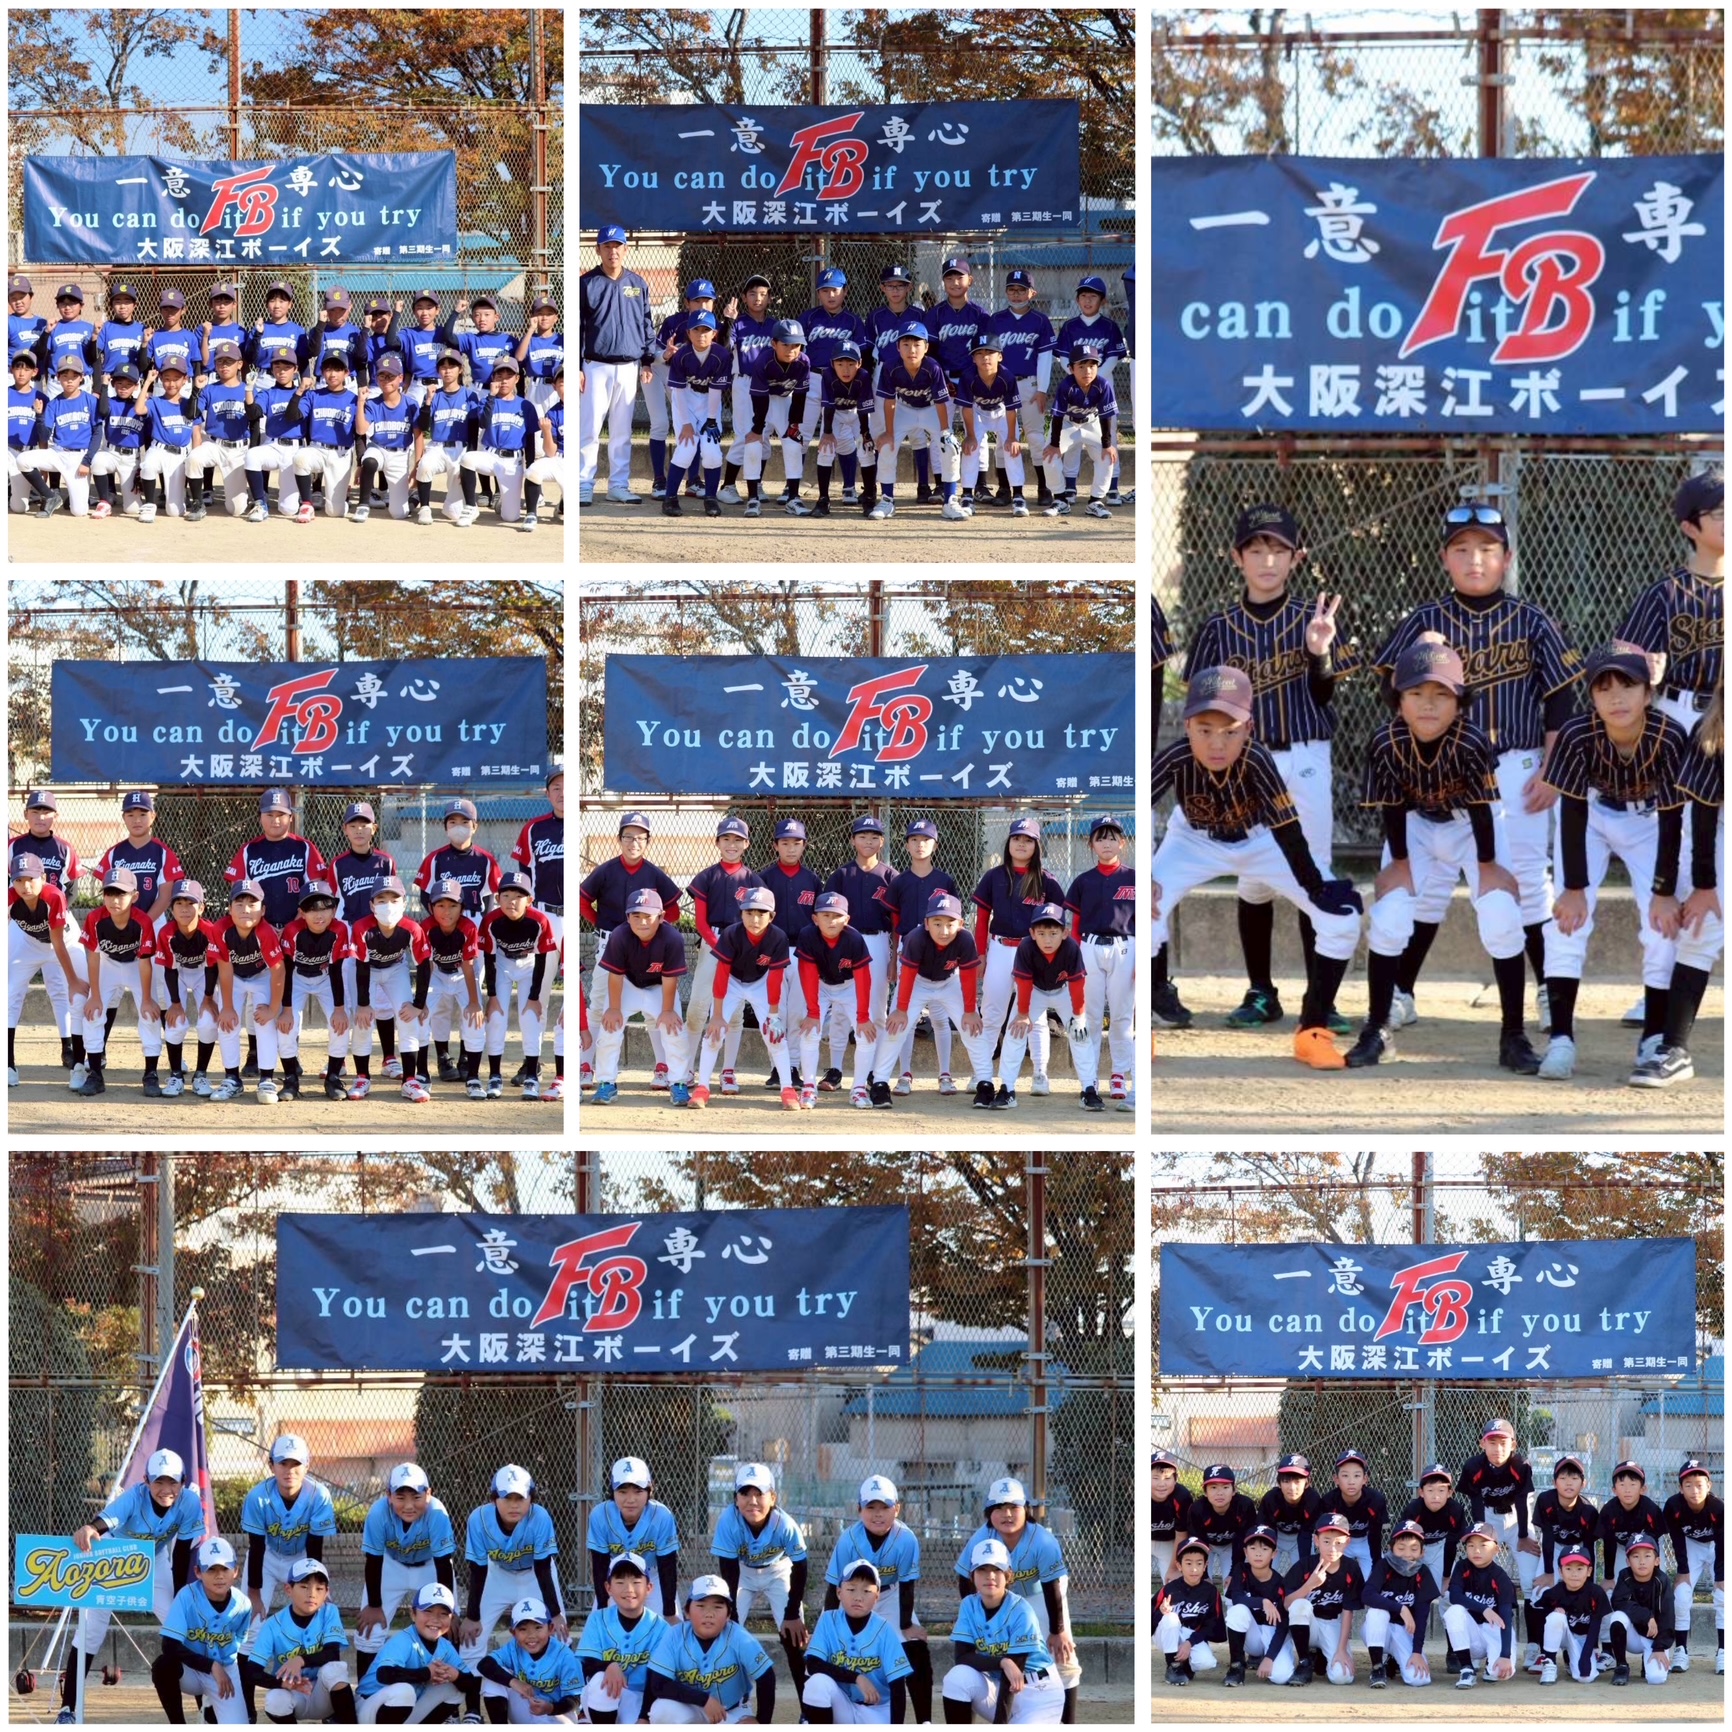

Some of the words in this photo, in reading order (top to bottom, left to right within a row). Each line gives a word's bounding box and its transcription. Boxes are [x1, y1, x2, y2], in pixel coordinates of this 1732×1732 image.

[773, 111, 869, 200] FB
[599, 164, 659, 189] You
[674, 170, 726, 189] can
[741, 165, 776, 189] do
[872, 165, 897, 190] if
[913, 168, 971, 193] you
[988, 163, 1038, 190] try
[199, 165, 279, 237] FB
[702, 199, 943, 226] 大阪深江ボーイズ
[48, 206, 99, 228] You
[112, 212, 157, 228] can
[170, 208, 200, 229] do
[281, 206, 303, 228] if
[317, 210, 366, 230] you
[380, 205, 422, 227] try
[137, 235, 341, 260] 大阪深江ボーイズ
[1398, 170, 1605, 364] FB
[1180, 300, 1293, 340] can
[1326, 286, 1403, 339] do
[1613, 289, 1666, 343] if
[1025, 348, 1035, 360] 7
[250, 668, 343, 754] FB
[828, 664, 933, 762] FB
[79, 718, 138, 742] You
[153, 725, 203, 744] can
[218, 719, 253, 744] do
[346, 720, 371, 745] if
[386, 724, 442, 748] you
[457, 719, 507, 745] try
[636, 720, 701, 747] You
[718, 728, 775, 748] can
[792, 722, 830, 749] do
[936, 724, 964, 751] if
[981, 728, 1045, 754] you
[1063, 723, 1118, 752] try
[180, 753, 415, 779] 大阪深江ボーイズ
[748, 761, 1014, 790] 大阪深江ボーイズ
[249, 855, 303, 876] Higanaka
[143, 876, 152, 890] 3
[286, 877, 300, 893] 10
[529, 1221, 648, 1333] FB
[312, 1287, 386, 1318] You
[405, 1295, 470, 1319] can
[488, 1288, 532, 1319] do
[652, 1289, 684, 1320] if
[704, 1294, 776, 1324] you
[796, 1287, 857, 1319] try
[1372, 1250, 1474, 1345] FB
[1189, 1306, 1252, 1332] You
[1268, 1313, 1323, 1333] can
[1338, 1307, 1376, 1333] do
[1477, 1308, 1504, 1334] if
[1521, 1313, 1582, 1338] you
[1598, 1307, 1652, 1333] try
[440, 1331, 740, 1364] 大阪深江ボーイズ
[1298, 1344, 1552, 1371] 大阪深江ボーイズ
[18, 1548, 150, 1600] Aozora
[96, 1595, 148, 1607] 青空子供会
